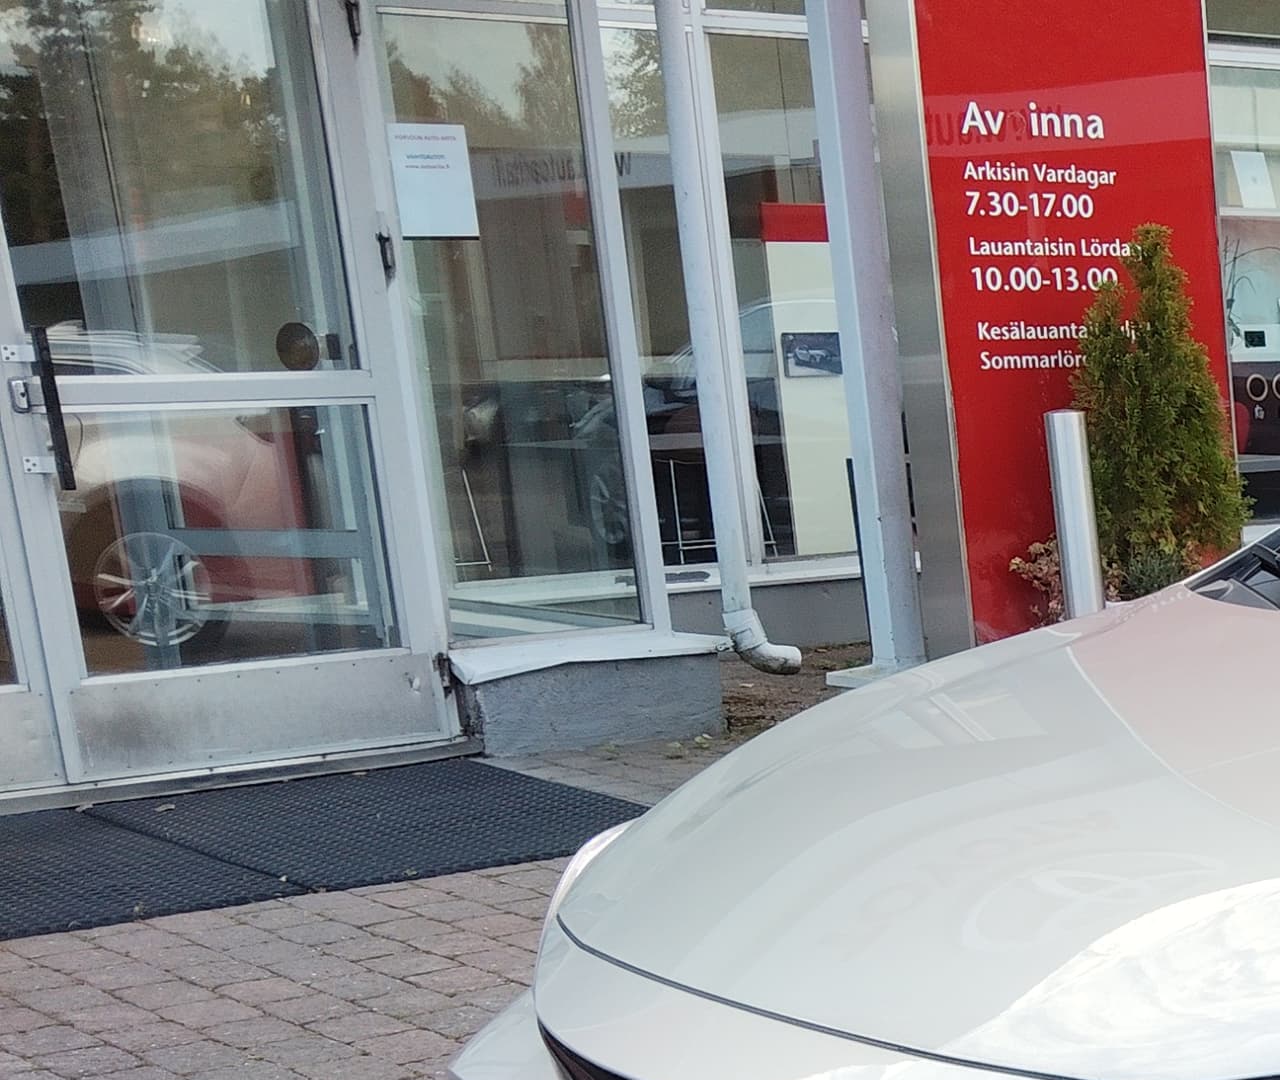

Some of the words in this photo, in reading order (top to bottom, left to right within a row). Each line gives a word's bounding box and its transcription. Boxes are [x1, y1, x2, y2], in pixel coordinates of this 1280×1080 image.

[961, 101, 1105, 140] Avinna
[963, 161, 1029, 182] Arkisin
[1033, 163, 1117, 190] Vardagar
[965, 191, 1094, 218] 7.30-17.00
[968, 236, 1076, 257] Lauantaisin
[971, 266, 1118, 292] 10.00-13.00
